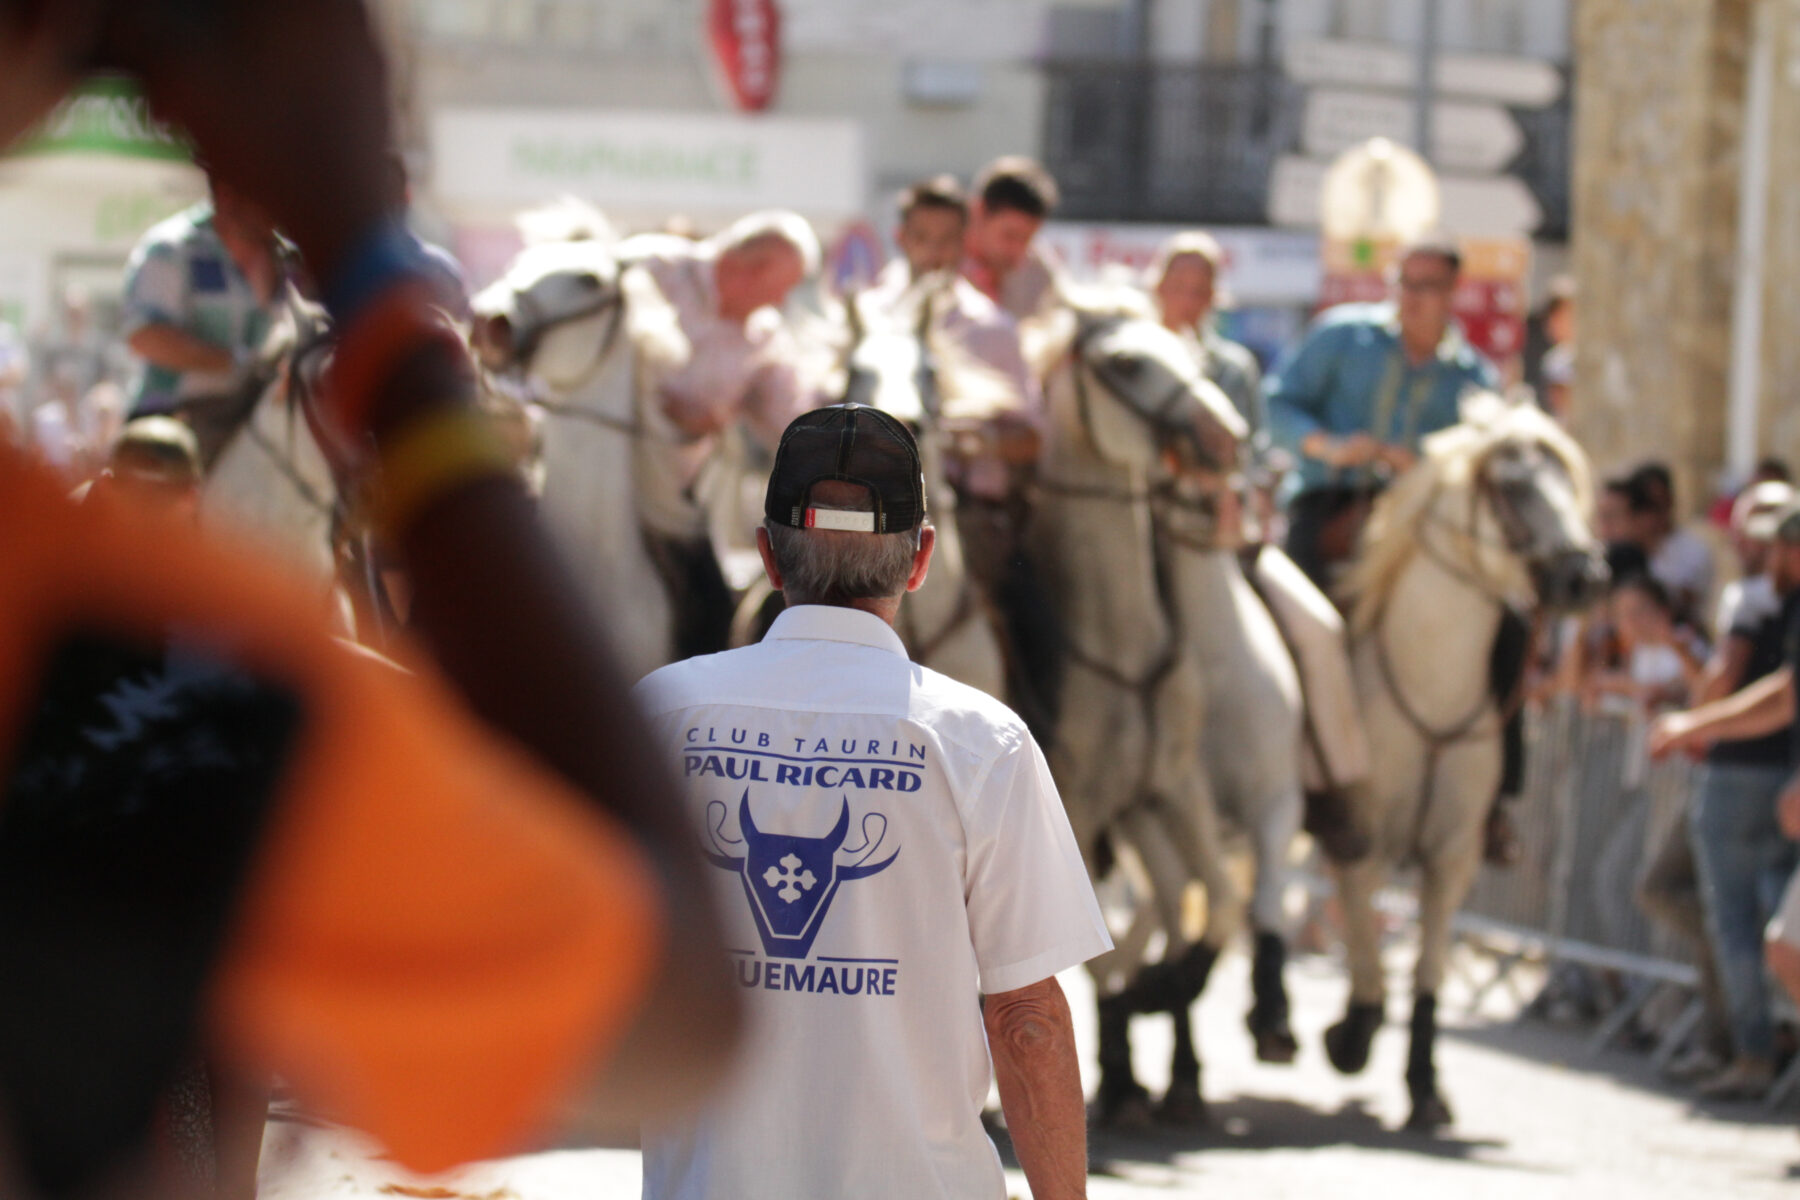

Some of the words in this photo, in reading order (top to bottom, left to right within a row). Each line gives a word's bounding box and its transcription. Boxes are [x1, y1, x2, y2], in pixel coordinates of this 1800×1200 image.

[686, 727, 770, 748] CLUB
[794, 738, 926, 760] TAURIN
[684, 755, 769, 782] PAUL
[776, 763, 922, 792] RICARD
[737, 959, 898, 996] UEMAURE
